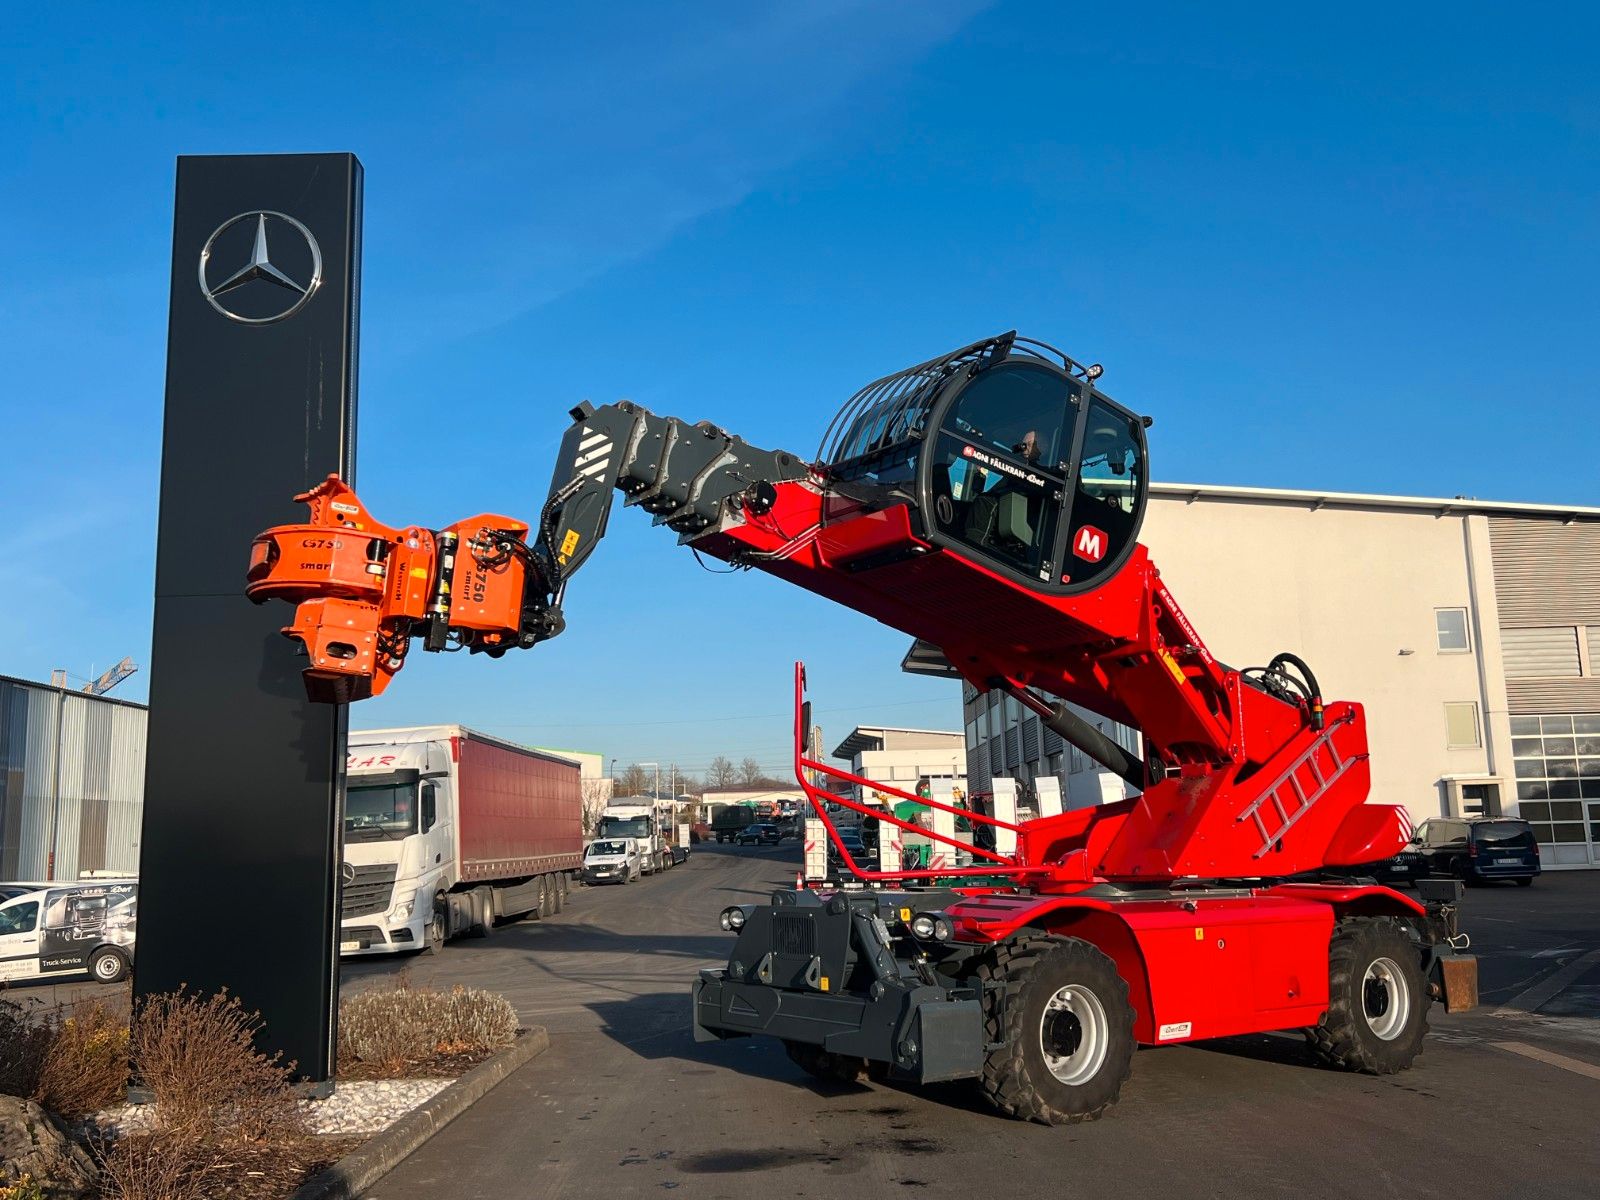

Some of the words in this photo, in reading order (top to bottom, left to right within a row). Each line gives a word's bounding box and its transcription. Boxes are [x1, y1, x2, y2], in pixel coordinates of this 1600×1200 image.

[1078, 528, 1100, 559] M
[463, 571, 472, 601] smart
[42, 957, 82, 968] Truck-Service
